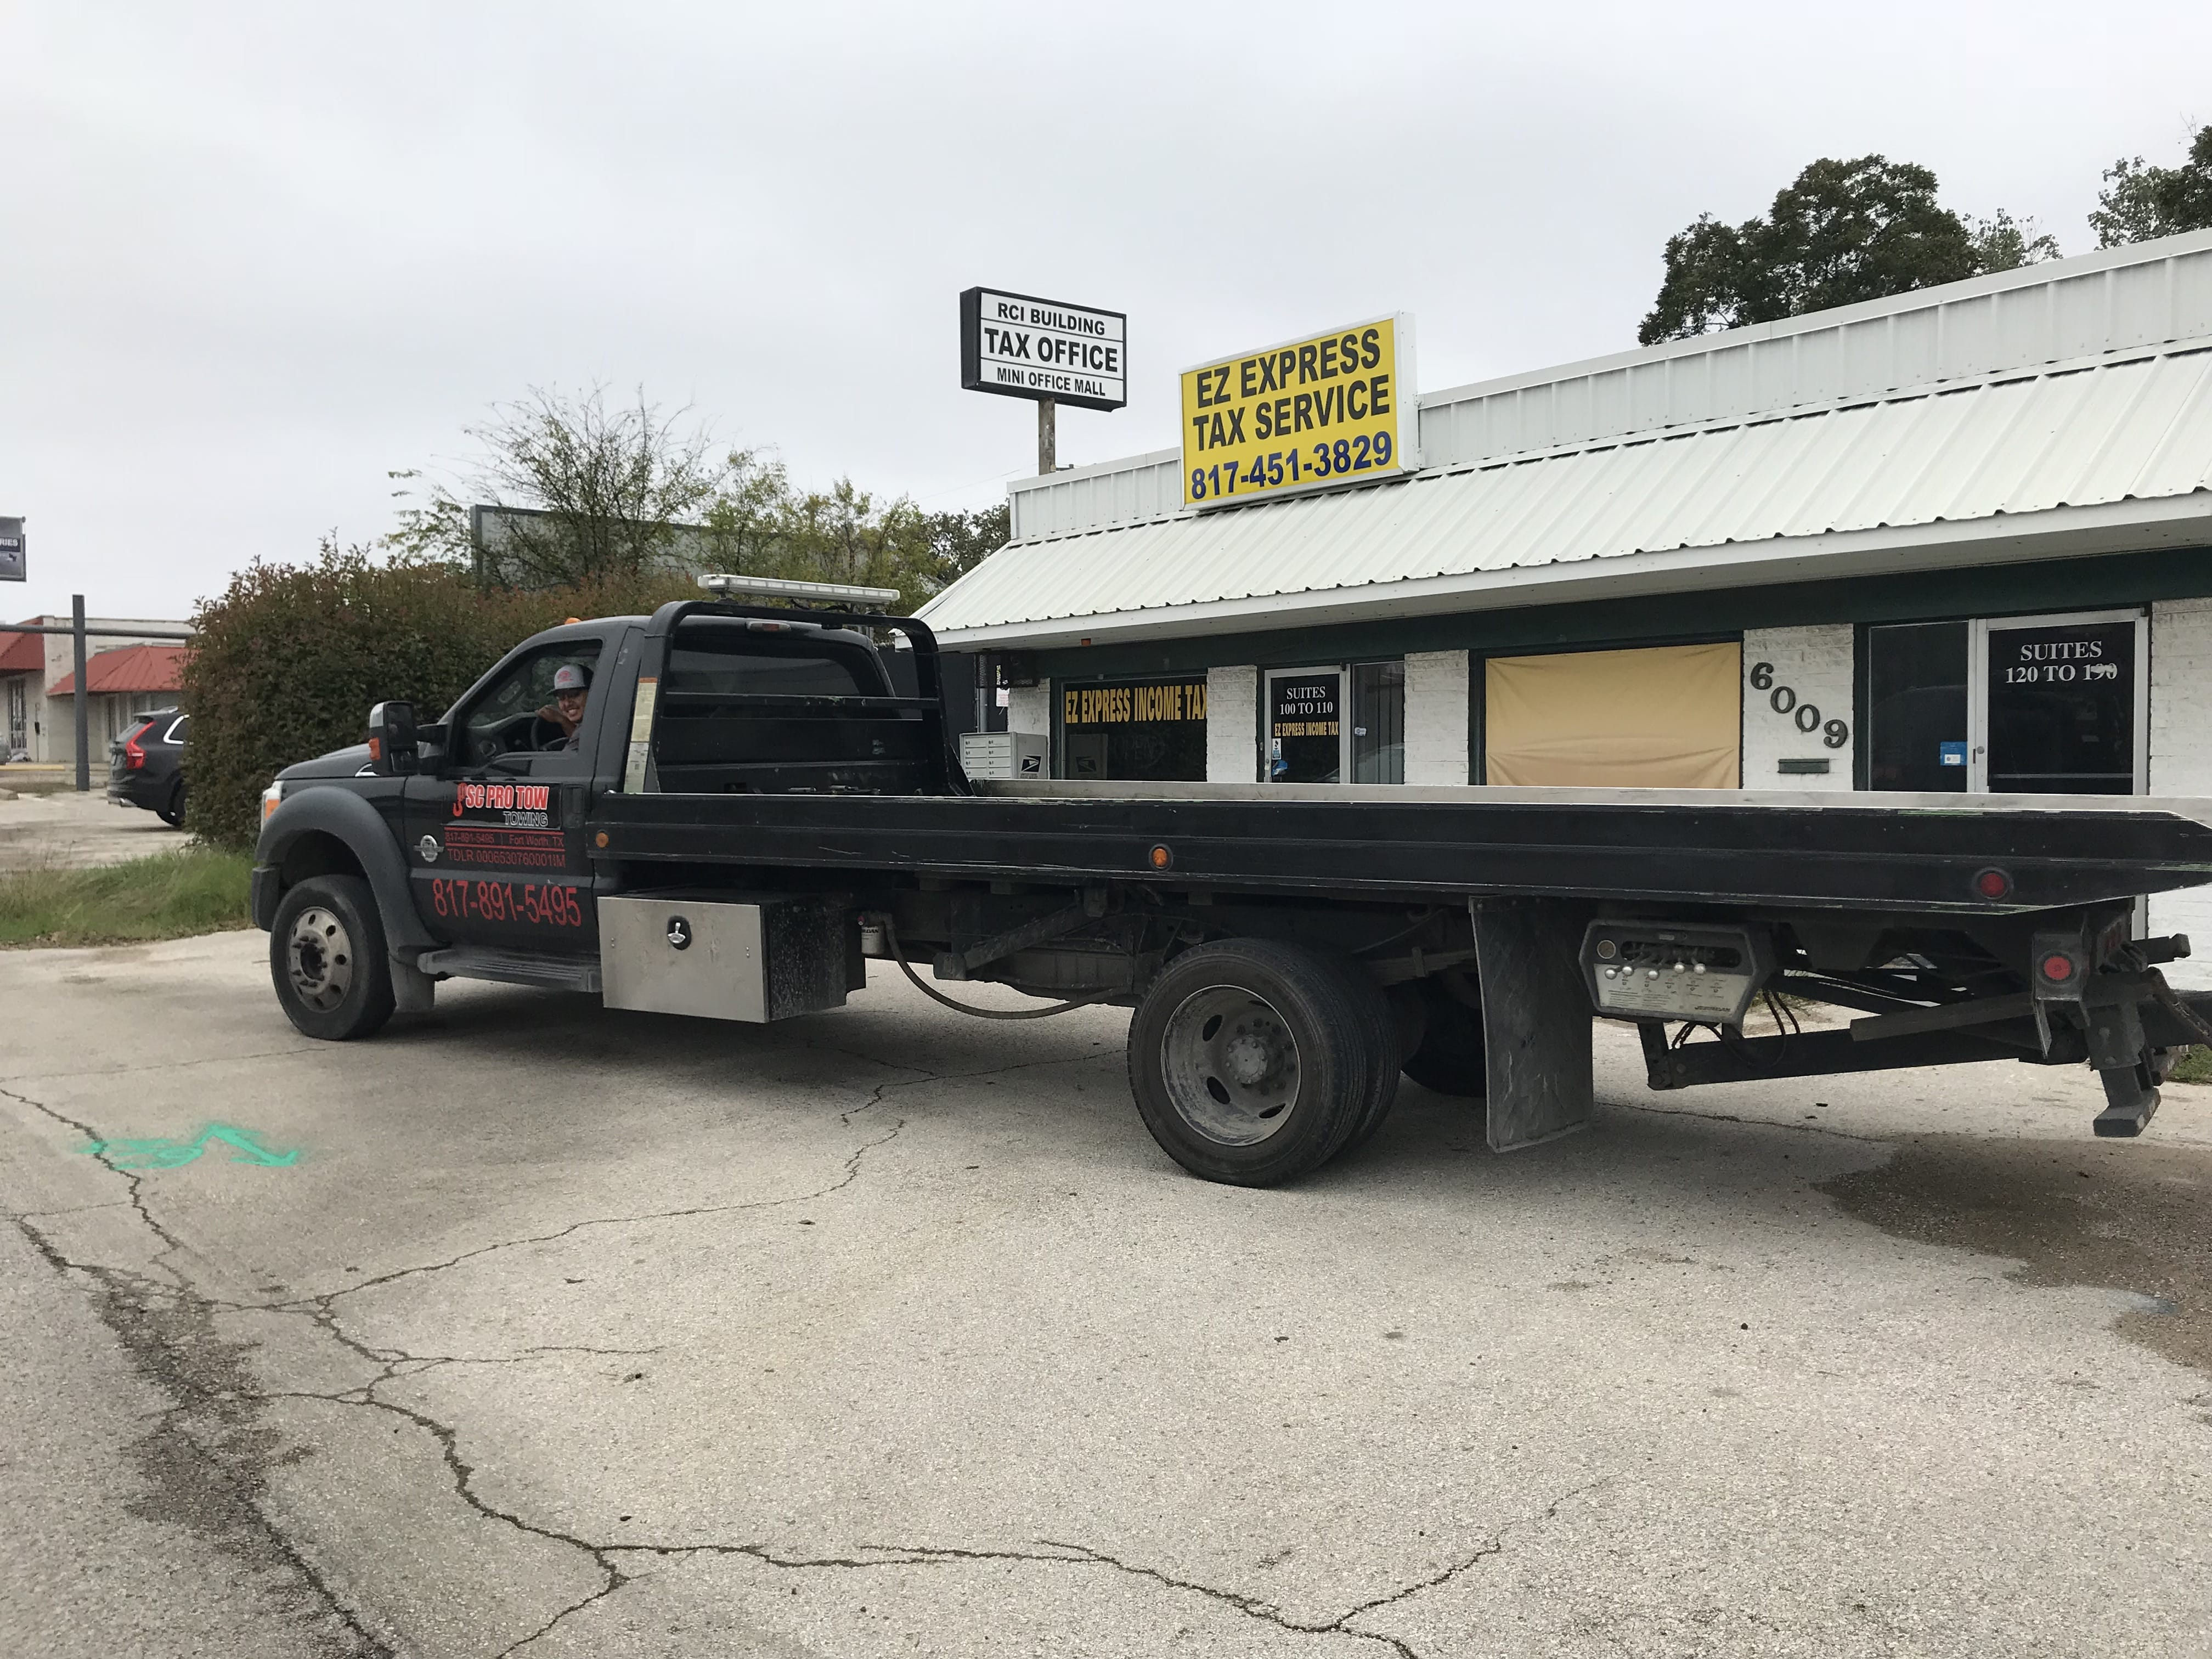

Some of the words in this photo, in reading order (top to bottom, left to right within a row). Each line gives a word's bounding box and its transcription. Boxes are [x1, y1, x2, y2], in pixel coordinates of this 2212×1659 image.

[998, 302, 1024, 321] RCI
[1030, 308, 1105, 335] BUILDING
[984, 328, 1030, 359] TAX
[1037, 337, 1118, 373] OFFICE
[1197, 366, 1231, 409] EZ
[1241, 328, 1380, 398] EXPRESS
[997, 368, 1024, 384] MINI
[1029, 372, 1070, 391] OFFICE
[1075, 379, 1105, 396] MALL
[1193, 407, 1246, 451] TAX
[1255, 374, 1390, 439] SERVICE
[1192, 431, 1392, 499] 817-451-3829
[2021, 641, 2102, 661] SUITES
[2006, 666, 2038, 683] 120
[2044, 664, 2076, 681] TO
[1065, 691, 1079, 724] EZ
[1082, 687, 1131, 723] EXPRESS
[1134, 685, 1181, 722] INCOME
[1185, 684, 1207, 720] TAX
[1286, 686, 1325, 699] SUITES
[1750, 662, 1848, 748] 6009
[1280, 703, 1296, 715] 100
[1298, 702, 1313, 714] TO
[1317, 701, 1333, 713] 110
[1274, 723, 1280, 737] EZ
[1282, 722, 1305, 736] EXPRESS
[1306, 722, 1327, 736] INCOME
[1328, 721, 1339, 736] TAX
[486, 786, 514, 809] PRO
[516, 786, 549, 810] TOW
[504, 811, 548, 827] TOWING
[509, 834, 524, 844] Fort
[526, 835, 548, 846] Worth
[553, 837, 564, 847] TX
[447, 849, 473, 861] TDLR
[432, 878, 582, 927] 817-891-5495
